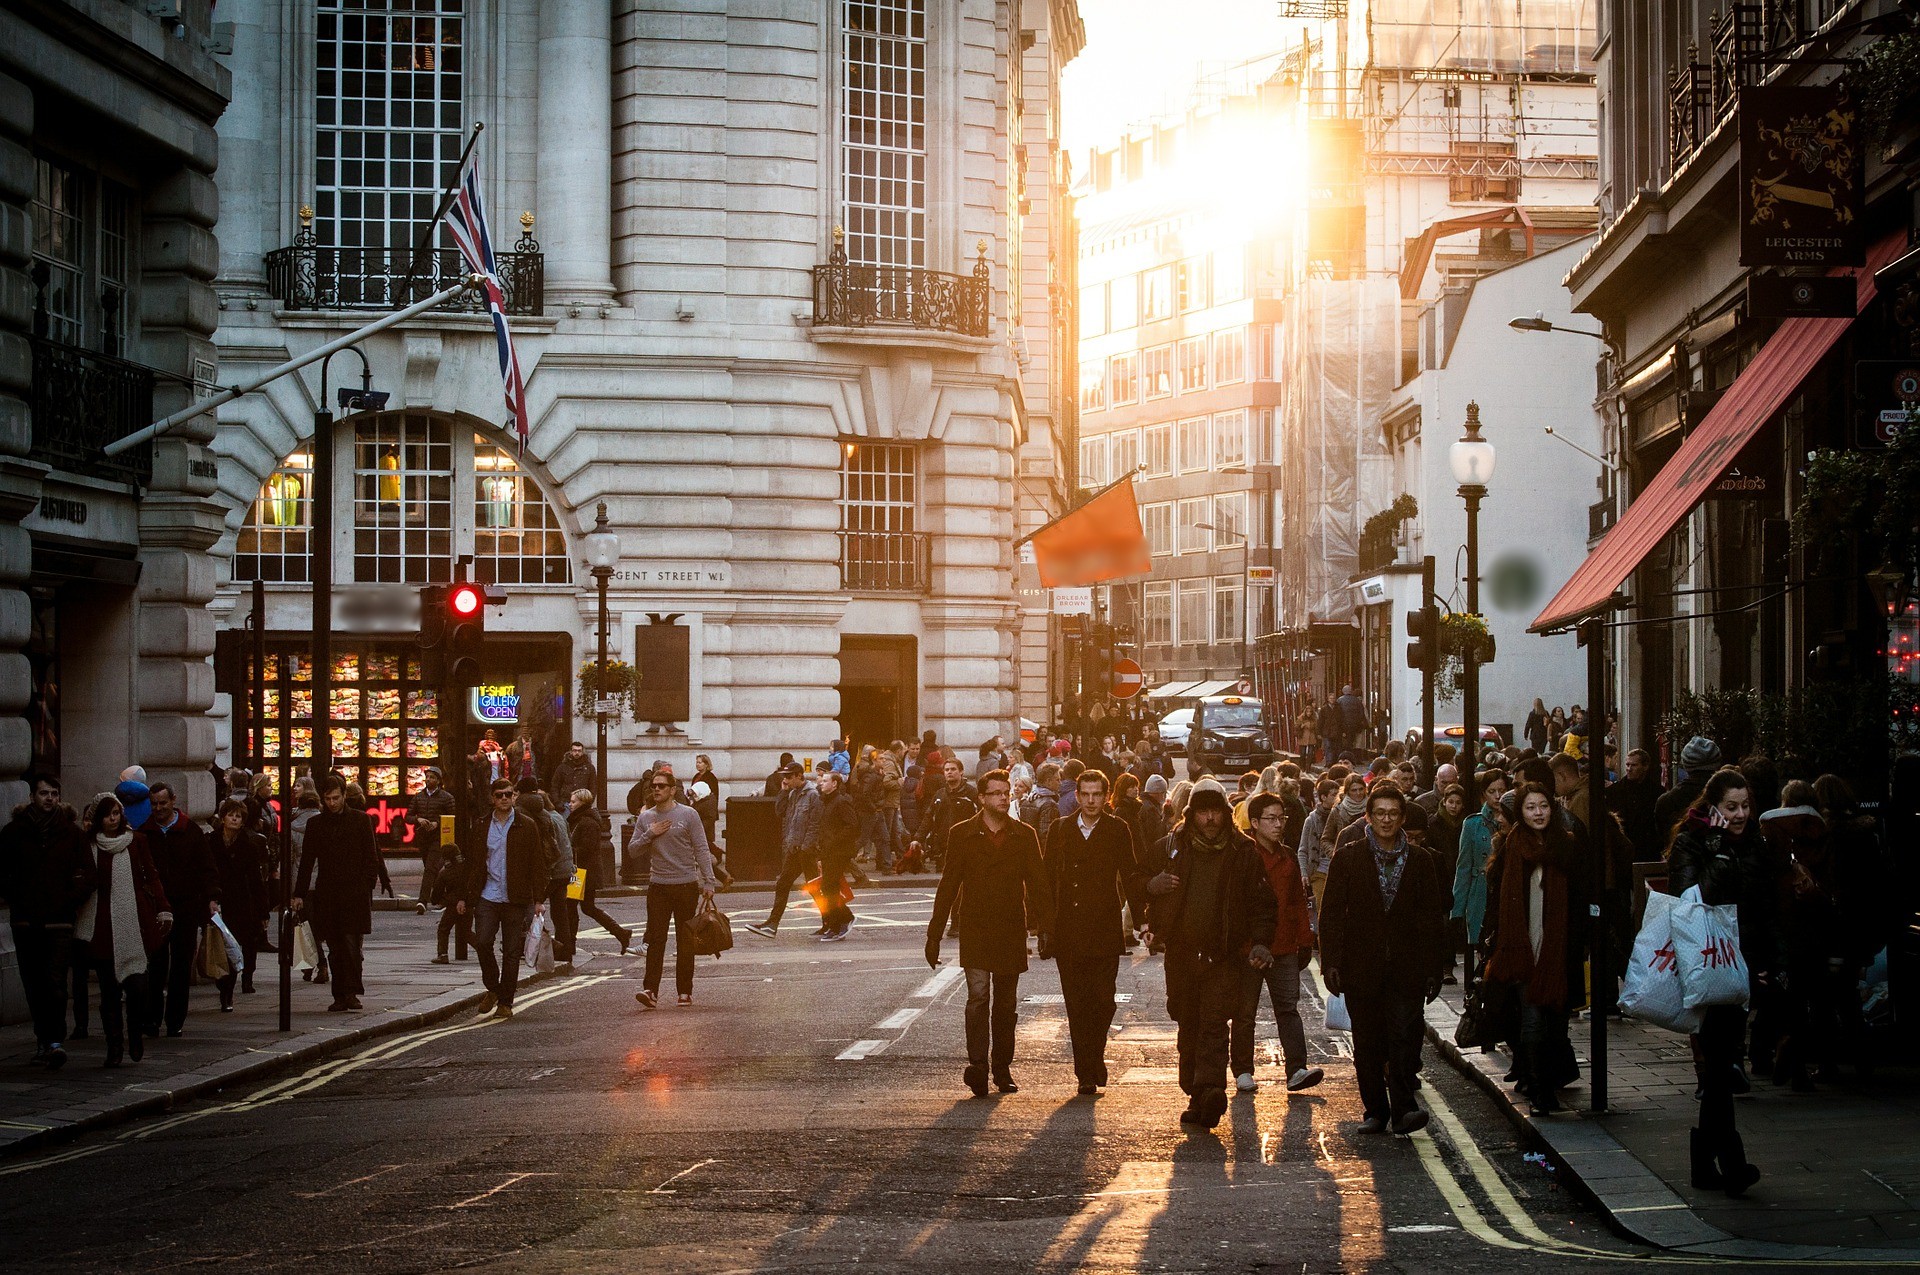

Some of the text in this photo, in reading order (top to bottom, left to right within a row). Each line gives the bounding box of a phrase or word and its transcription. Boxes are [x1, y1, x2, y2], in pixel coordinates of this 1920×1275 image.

[1765, 237, 1843, 248] LEICESTER
[1784, 251, 1825, 261] ARMS
[1883, 412, 1906, 420] PROUD
[1716, 475, 1766, 491] ndo's
[609, 571, 648, 581] GENT
[657, 571, 701, 581] STREET
[479, 686, 515, 697] T-SHIRT
[1648, 934, 1739, 976] H& H&M
